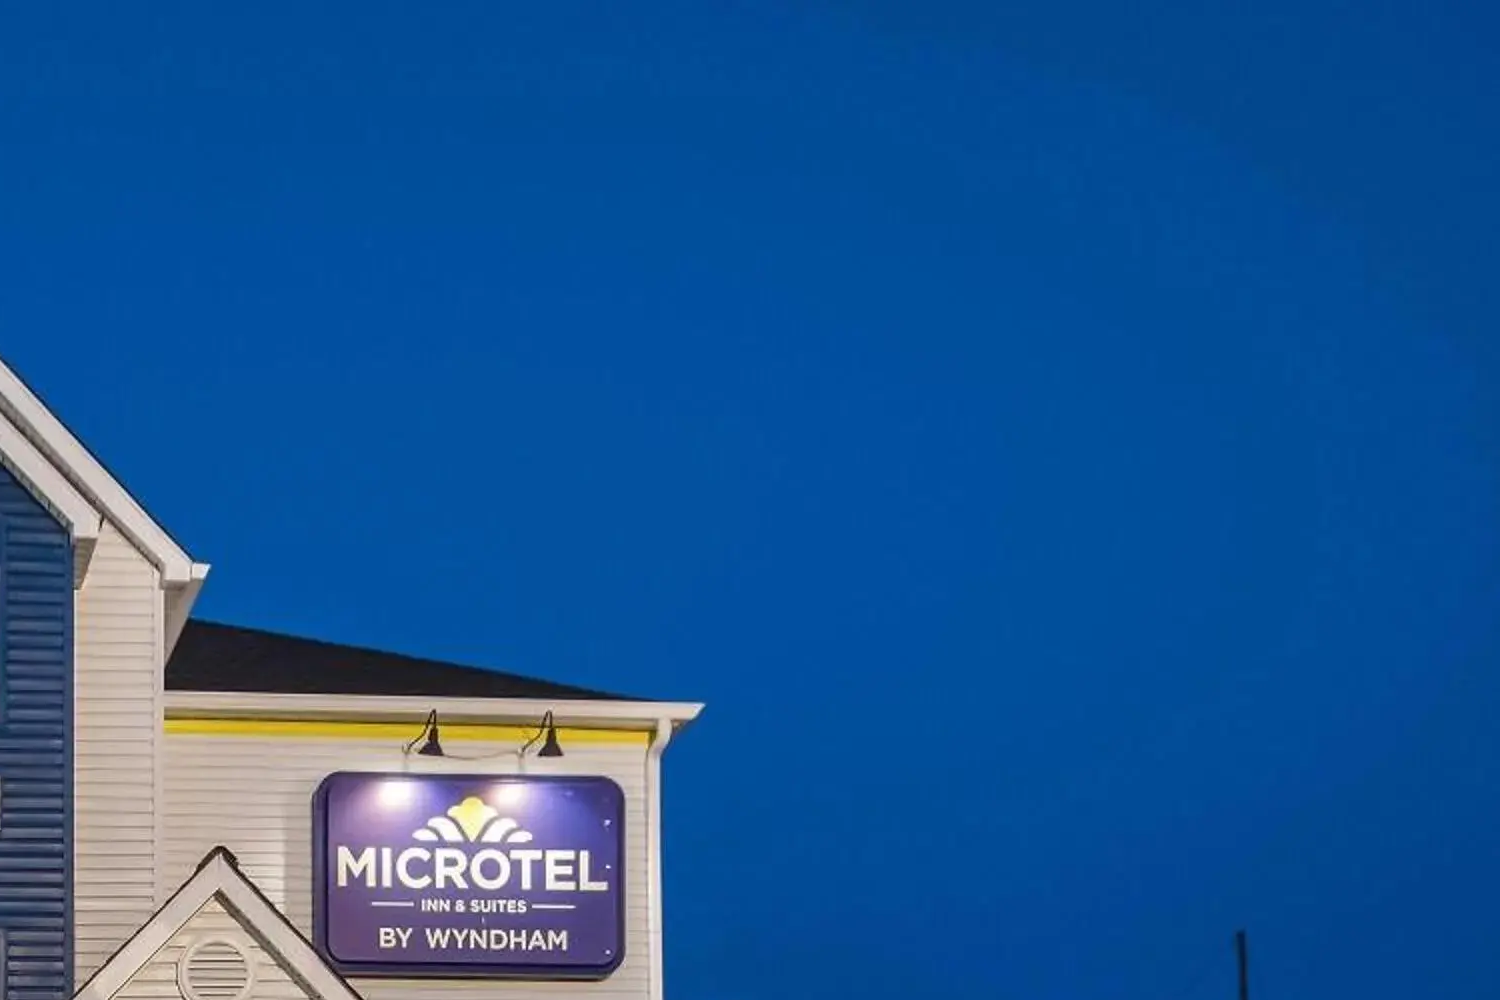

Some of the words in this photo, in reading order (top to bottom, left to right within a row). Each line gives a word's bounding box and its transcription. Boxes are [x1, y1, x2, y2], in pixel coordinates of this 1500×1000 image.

[336, 845, 609, 891] MICROTEL
[421, 899, 452, 912] INN
[455, 900, 464, 912] &
[470, 899, 527, 913] SUITES
[378, 927, 413, 948] BY
[426, 928, 568, 951] WYNDHAM
